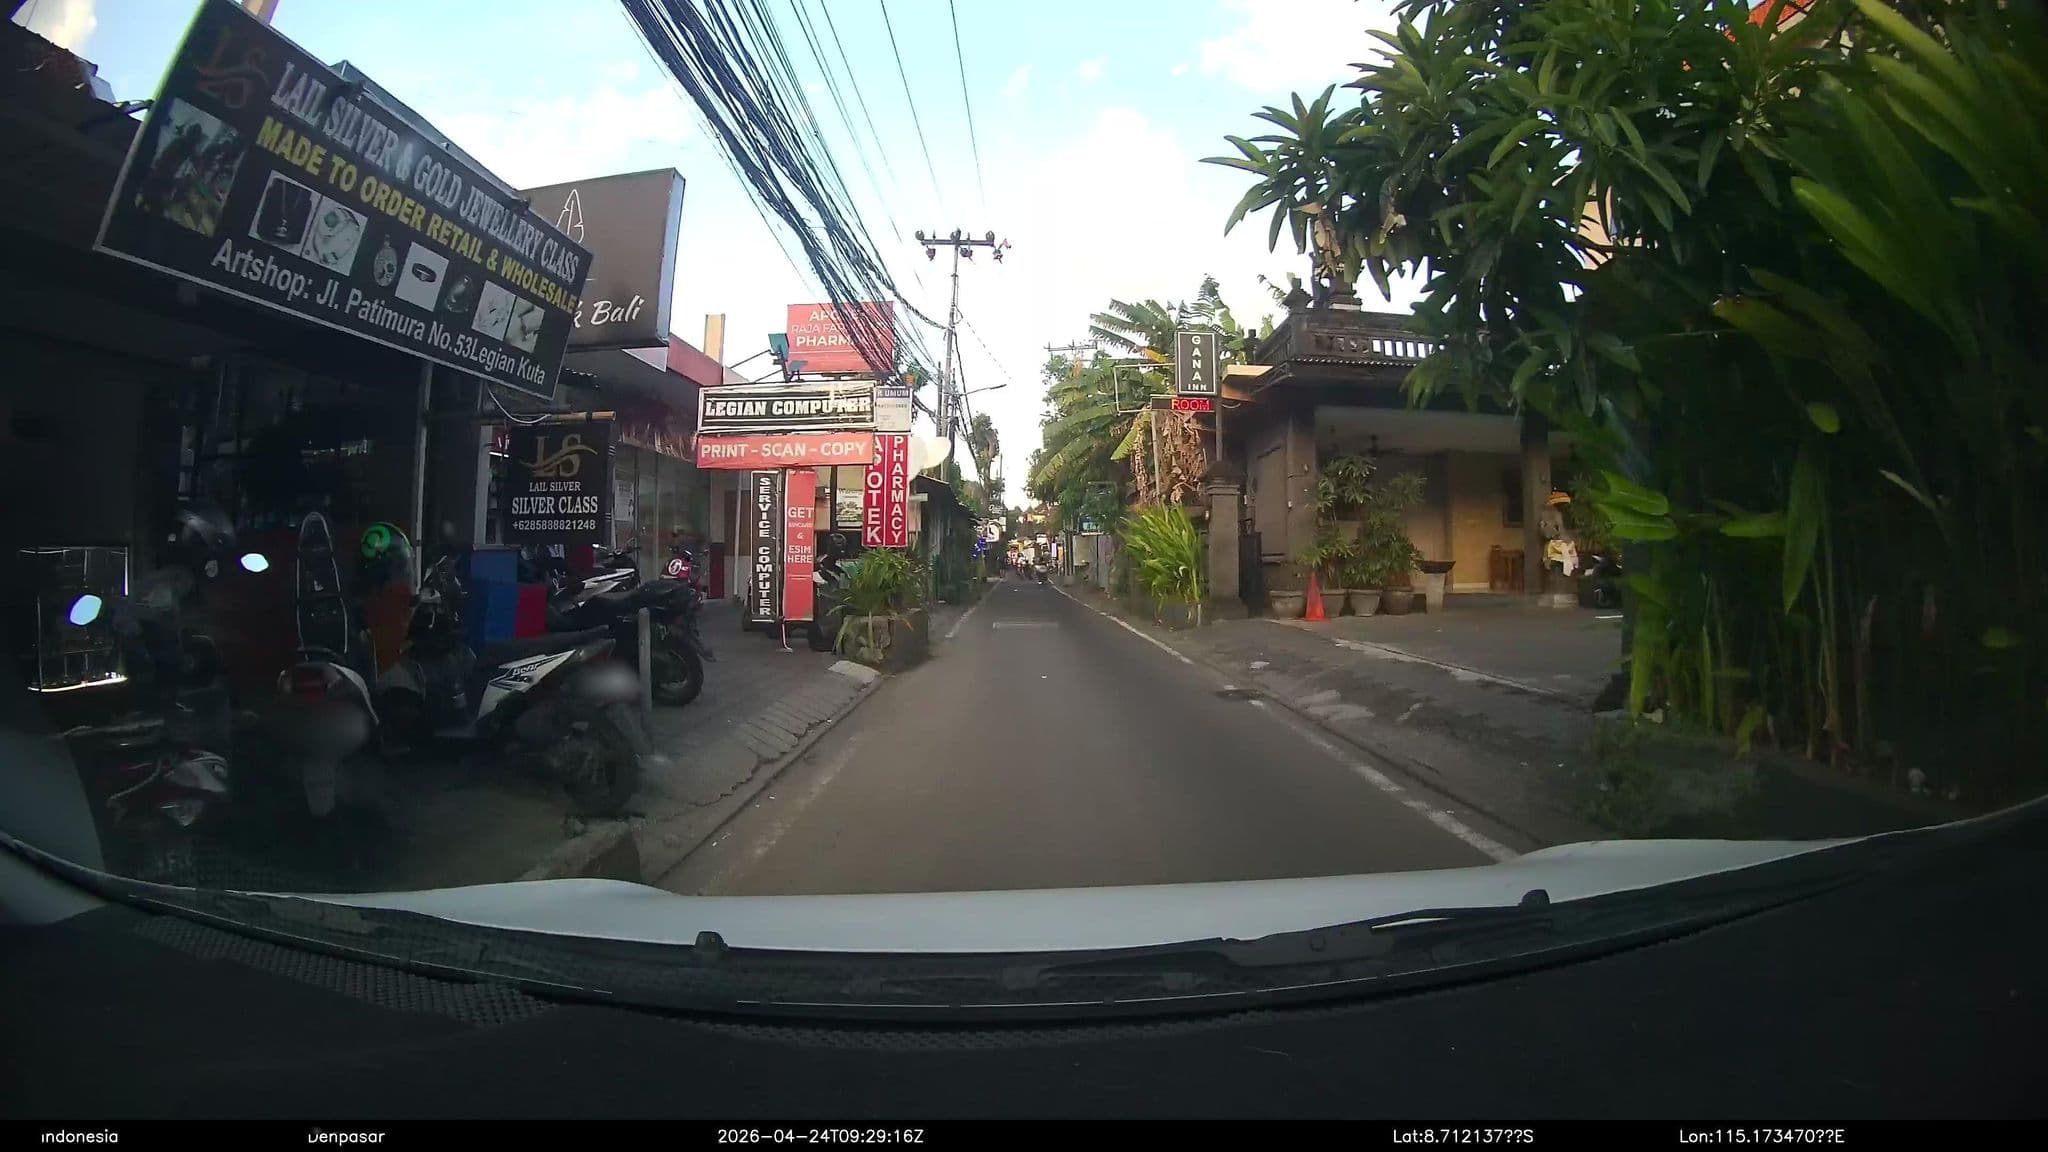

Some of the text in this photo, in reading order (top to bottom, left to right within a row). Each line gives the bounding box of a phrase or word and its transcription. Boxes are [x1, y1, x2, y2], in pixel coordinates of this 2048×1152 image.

[271, 61, 327, 128] LAIL
[323, 96, 399, 173] SILVER
[414, 155, 462, 208] GOLD
[460, 186, 544, 260] JEWELLERY
[541, 237, 580, 284] CLASS
[256, 115, 577, 313] MADE TO ORDER RETAIL & WHOLESALE
[211, 239, 312, 300] Artshop:
[316, 279, 339, 310] Jl.
[345, 288, 426, 341] Patimura
[517, 356, 546, 385] Kuta
[591, 295, 644, 325] Bali
[1191, 335, 1202, 381] GANA
[1187, 383, 1207, 391] INN
[705, 400, 767, 417] LEGIAN
[1171, 399, 1210, 410] ROOM
[701, 443, 748, 458] PRINT
[761, 443, 805, 457] SCAN
[820, 441, 867, 456] COPY
[529, 481, 581, 491] LAIL SILVER
[891, 436, 904, 543] PHARMACY
[512, 496, 598, 514] SILVER CLASS
[758, 477, 771, 538] SERVICE
[788, 507, 814, 519] GET
[512, 519, 596, 531] +6285888821248
[788, 545, 811, 554] ESIM
[787, 554, 813, 563] HERE
[756, 547, 773, 615] COMPUTER
